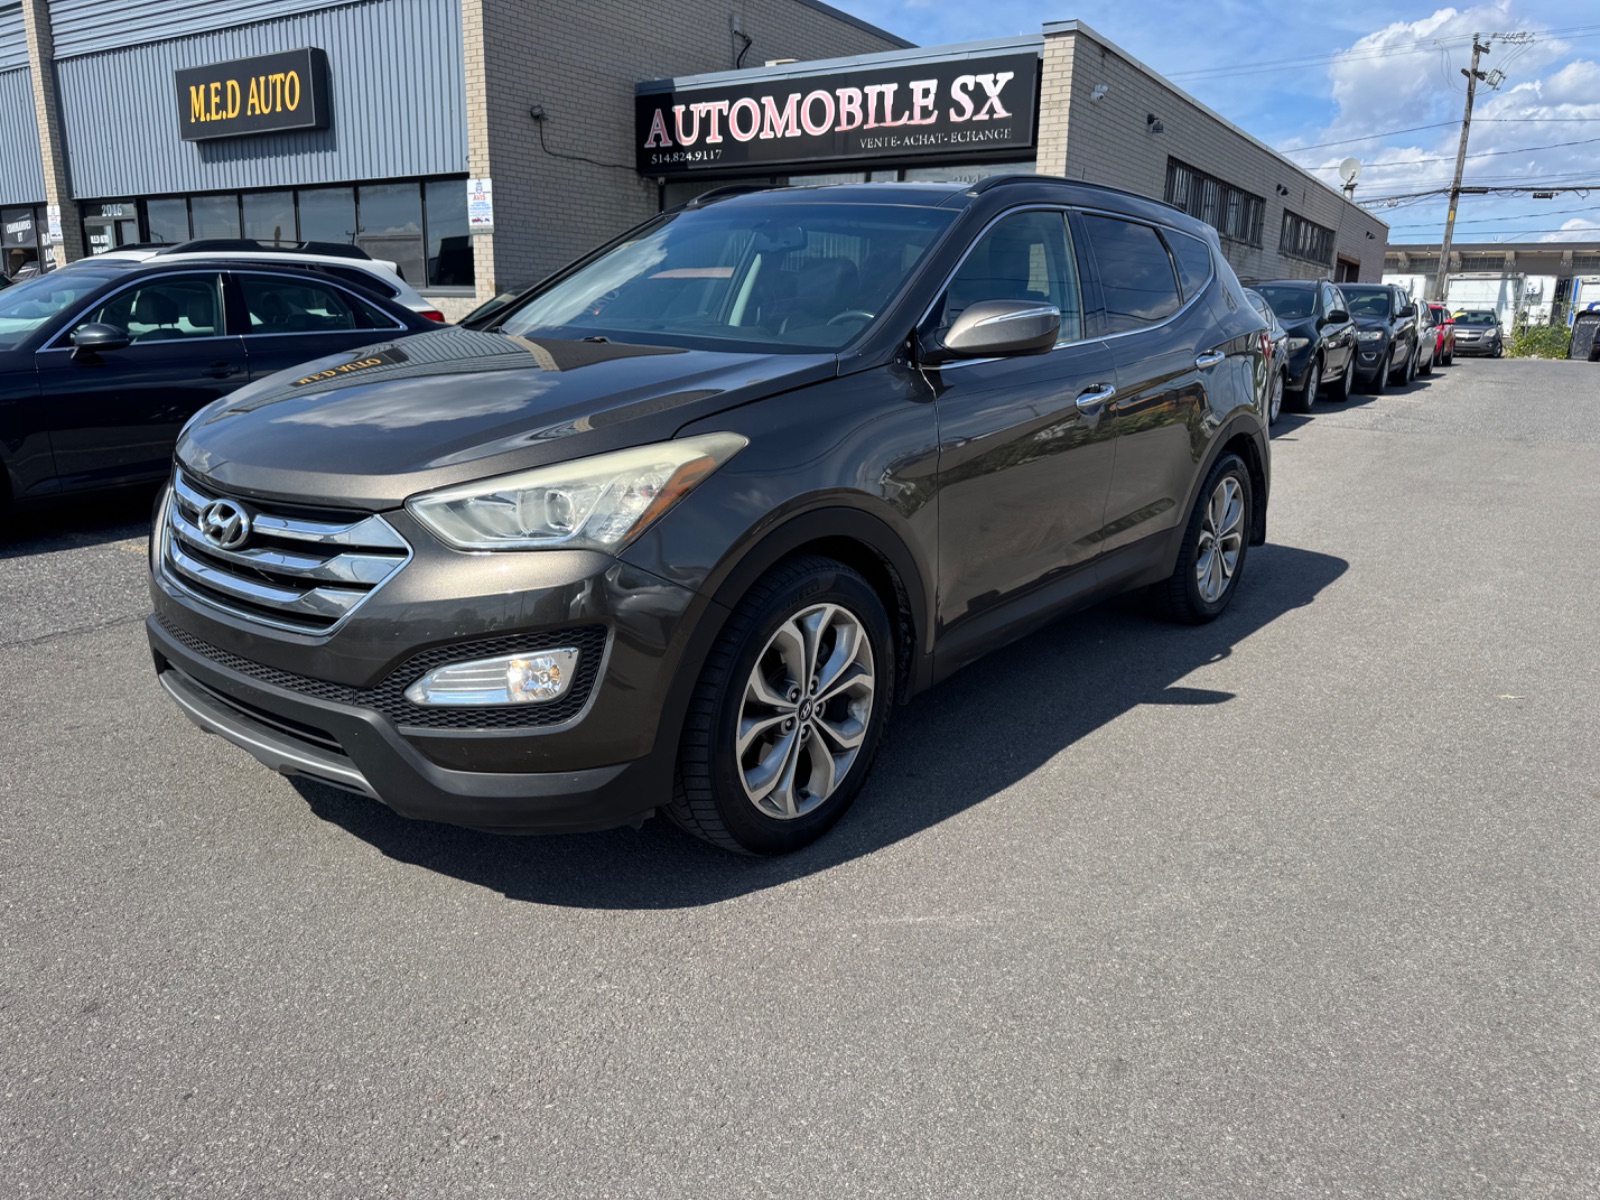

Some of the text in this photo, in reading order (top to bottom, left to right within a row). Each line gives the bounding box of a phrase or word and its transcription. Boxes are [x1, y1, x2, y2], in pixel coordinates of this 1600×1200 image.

[190, 70, 300, 123] M.E.D AUTO
[644, 71, 1014, 148] AUTOMOBILE SX
[951, 128, 1012, 143] ECHANGE
[651, 149, 722, 165] 514.824.9117
